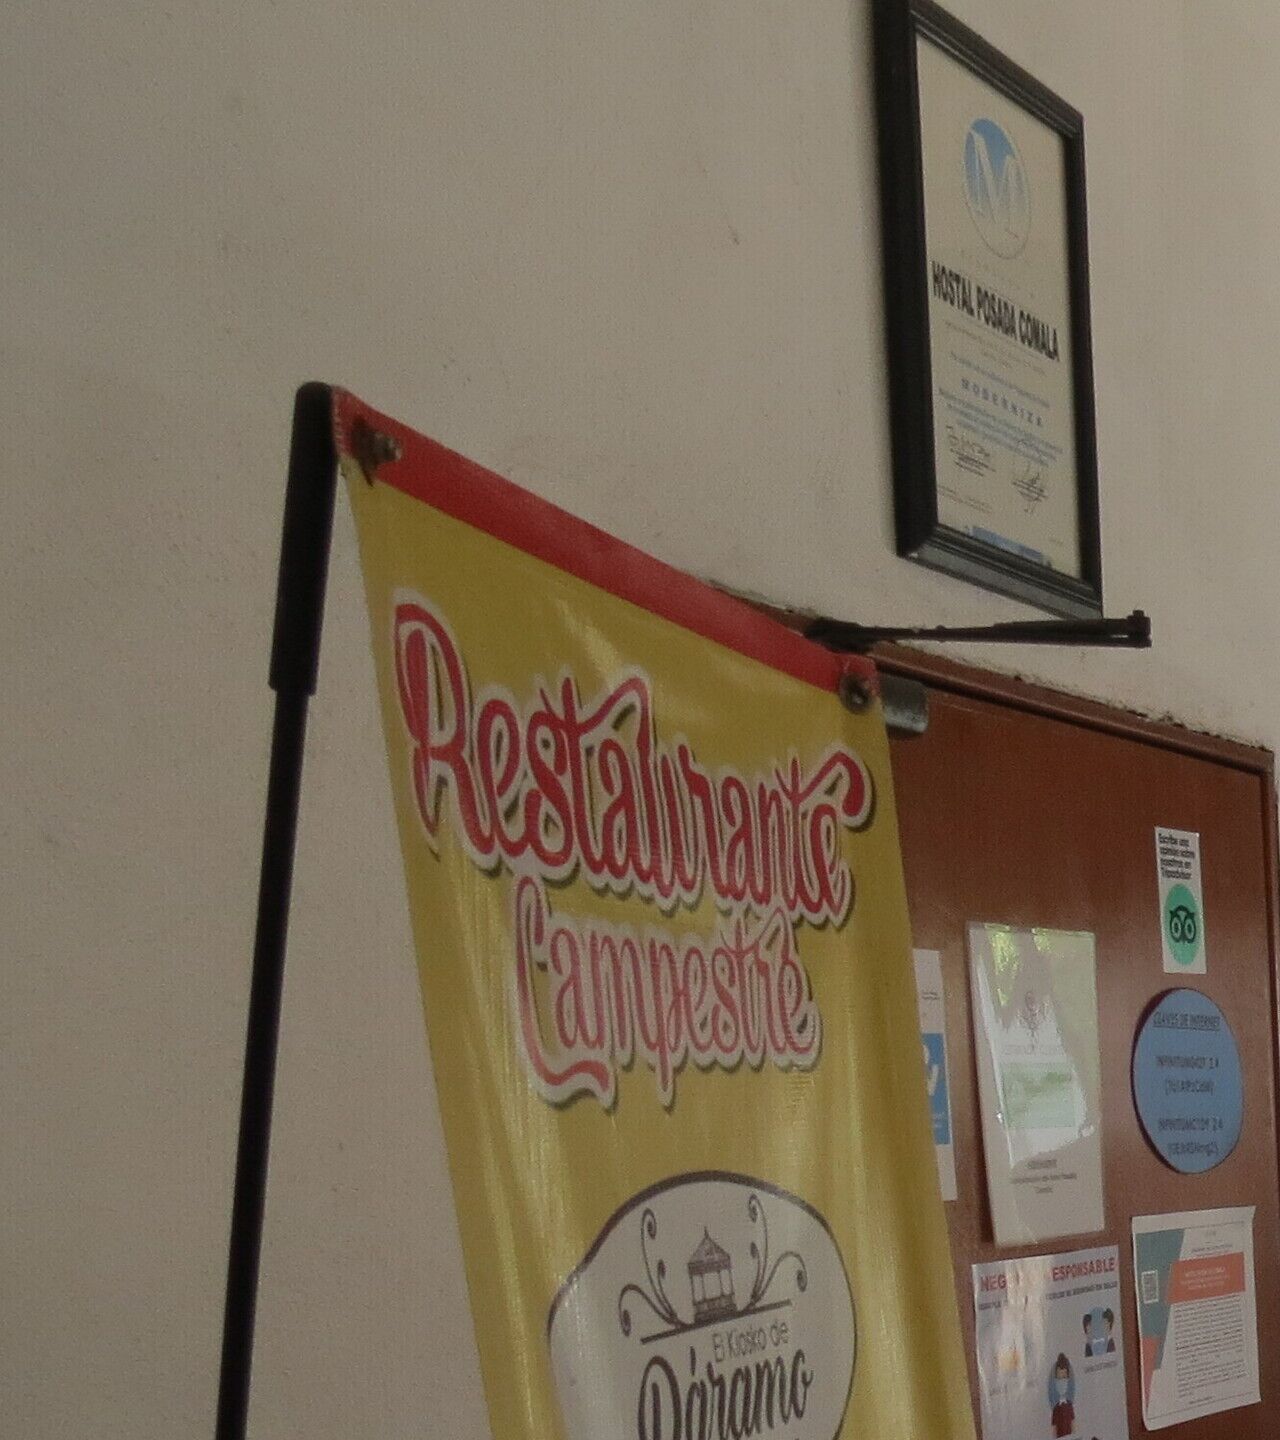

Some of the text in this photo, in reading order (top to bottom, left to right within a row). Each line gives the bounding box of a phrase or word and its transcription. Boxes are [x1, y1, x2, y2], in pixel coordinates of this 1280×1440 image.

[932, 260, 975, 318] HOSTAL
[976, 284, 1017, 341] POSADA
[1019, 308, 1060, 362] COMALA
[393, 600, 870, 917] Restaurante
[514, 876, 817, 1095] Campestre
[1052, 1256, 1116, 1283] ESPONSABLE
[711, 1320, 790, 1364] El Kiosko de
